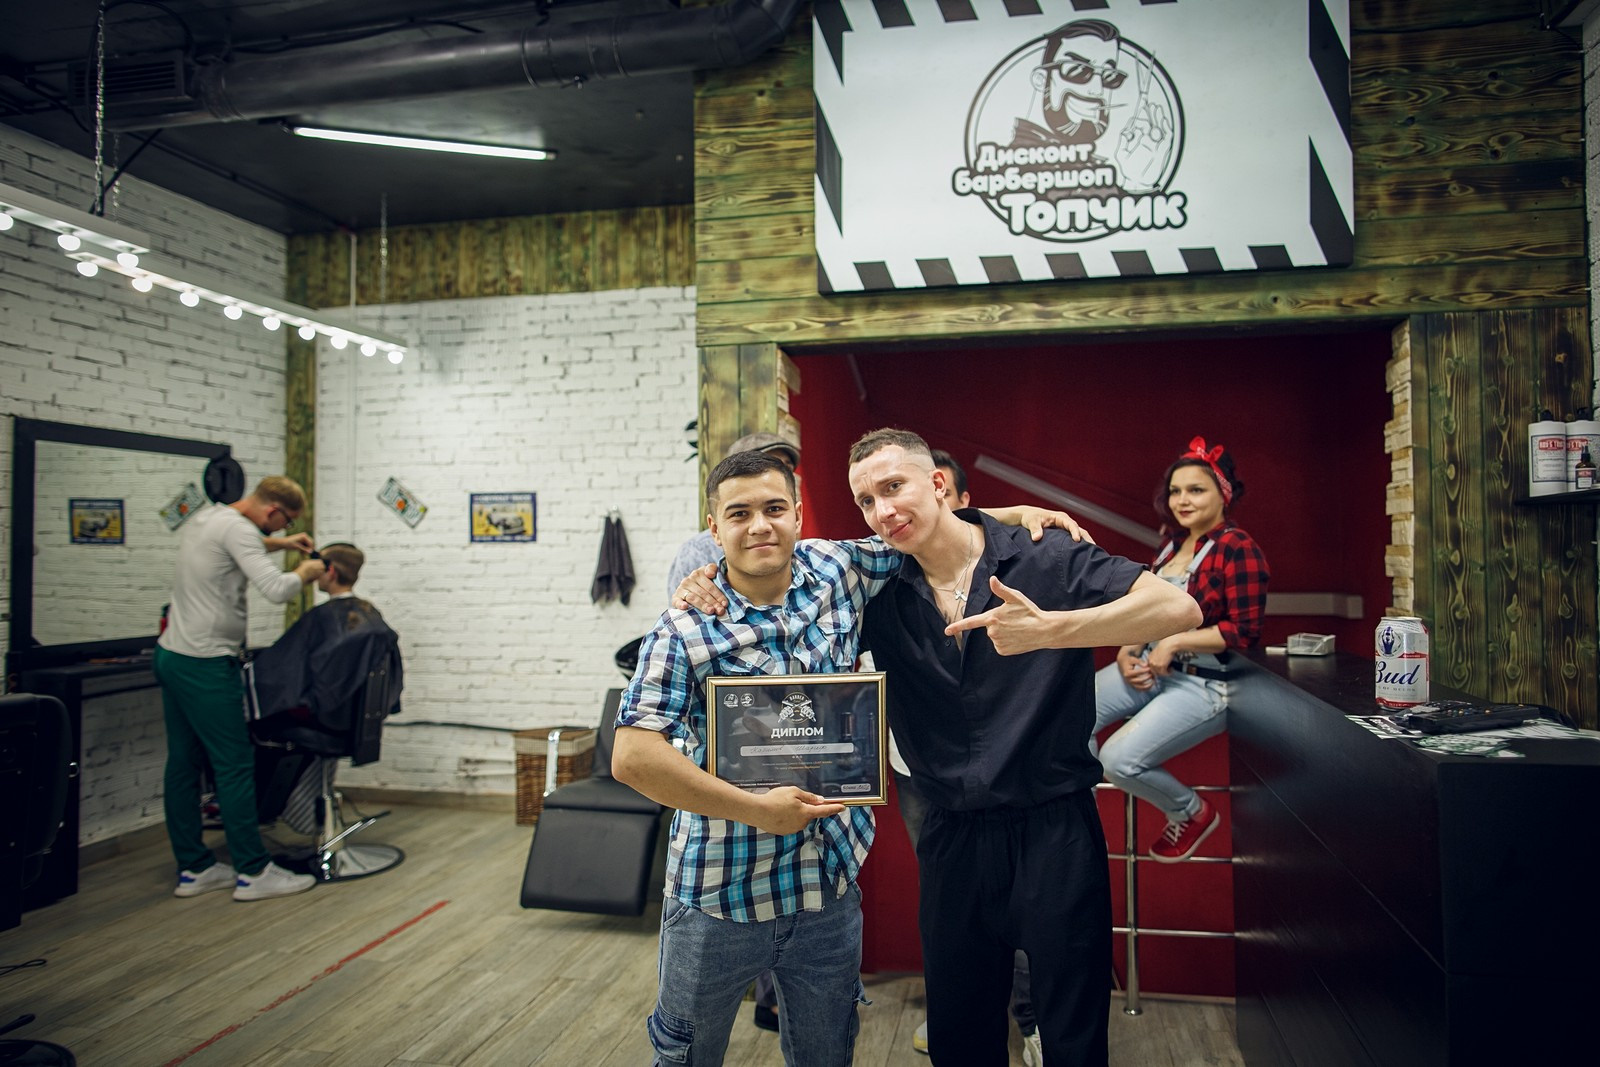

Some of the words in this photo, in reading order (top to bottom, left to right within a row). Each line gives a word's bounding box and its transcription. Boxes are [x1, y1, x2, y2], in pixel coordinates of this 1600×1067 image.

[976, 143, 1093, 171] Дисконт
[955, 167, 1114, 196] барбершоп
[1000, 192, 1187, 233] Топчик
[1375, 660, 1420, 685] Bud
[770, 726, 824, 739] ДИПЛОМ
